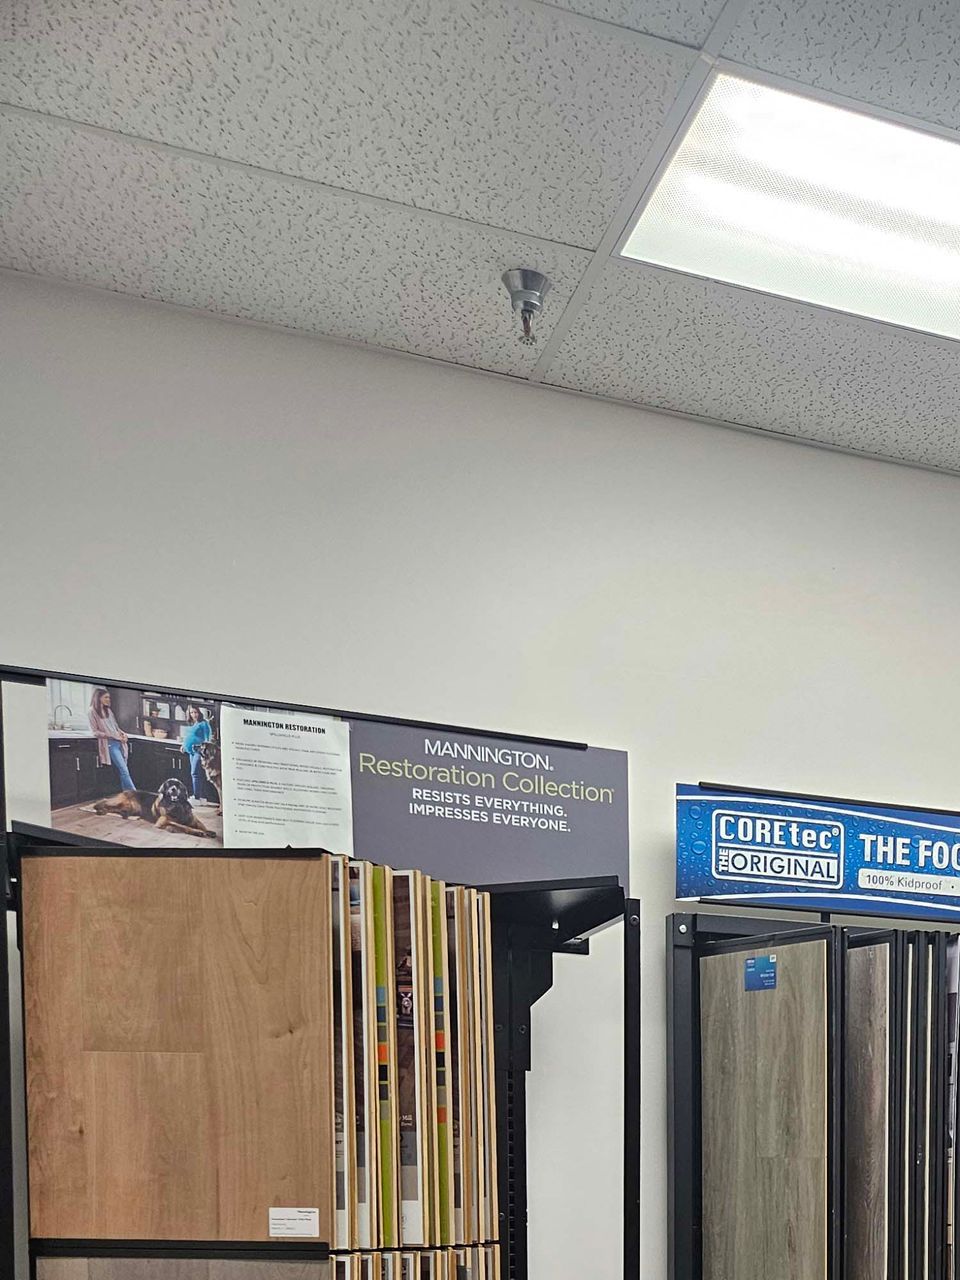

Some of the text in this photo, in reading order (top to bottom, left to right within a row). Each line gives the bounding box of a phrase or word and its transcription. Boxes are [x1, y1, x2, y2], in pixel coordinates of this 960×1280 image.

[243, 719, 326, 734] MANNINGTON RESTORATION
[359, 752, 495, 788] Restoration
[412, 788, 568, 817] RESISTS EVERYTHING.
[409, 803, 572, 832] IMPRESSES EVERYONE.
[718, 848, 729, 872] THE
[859, 834, 911, 866] THE
[731, 853, 836, 879] ORIGINAL
[866, 874, 895, 887] 100%
[897, 876, 943, 891] Kidproof
